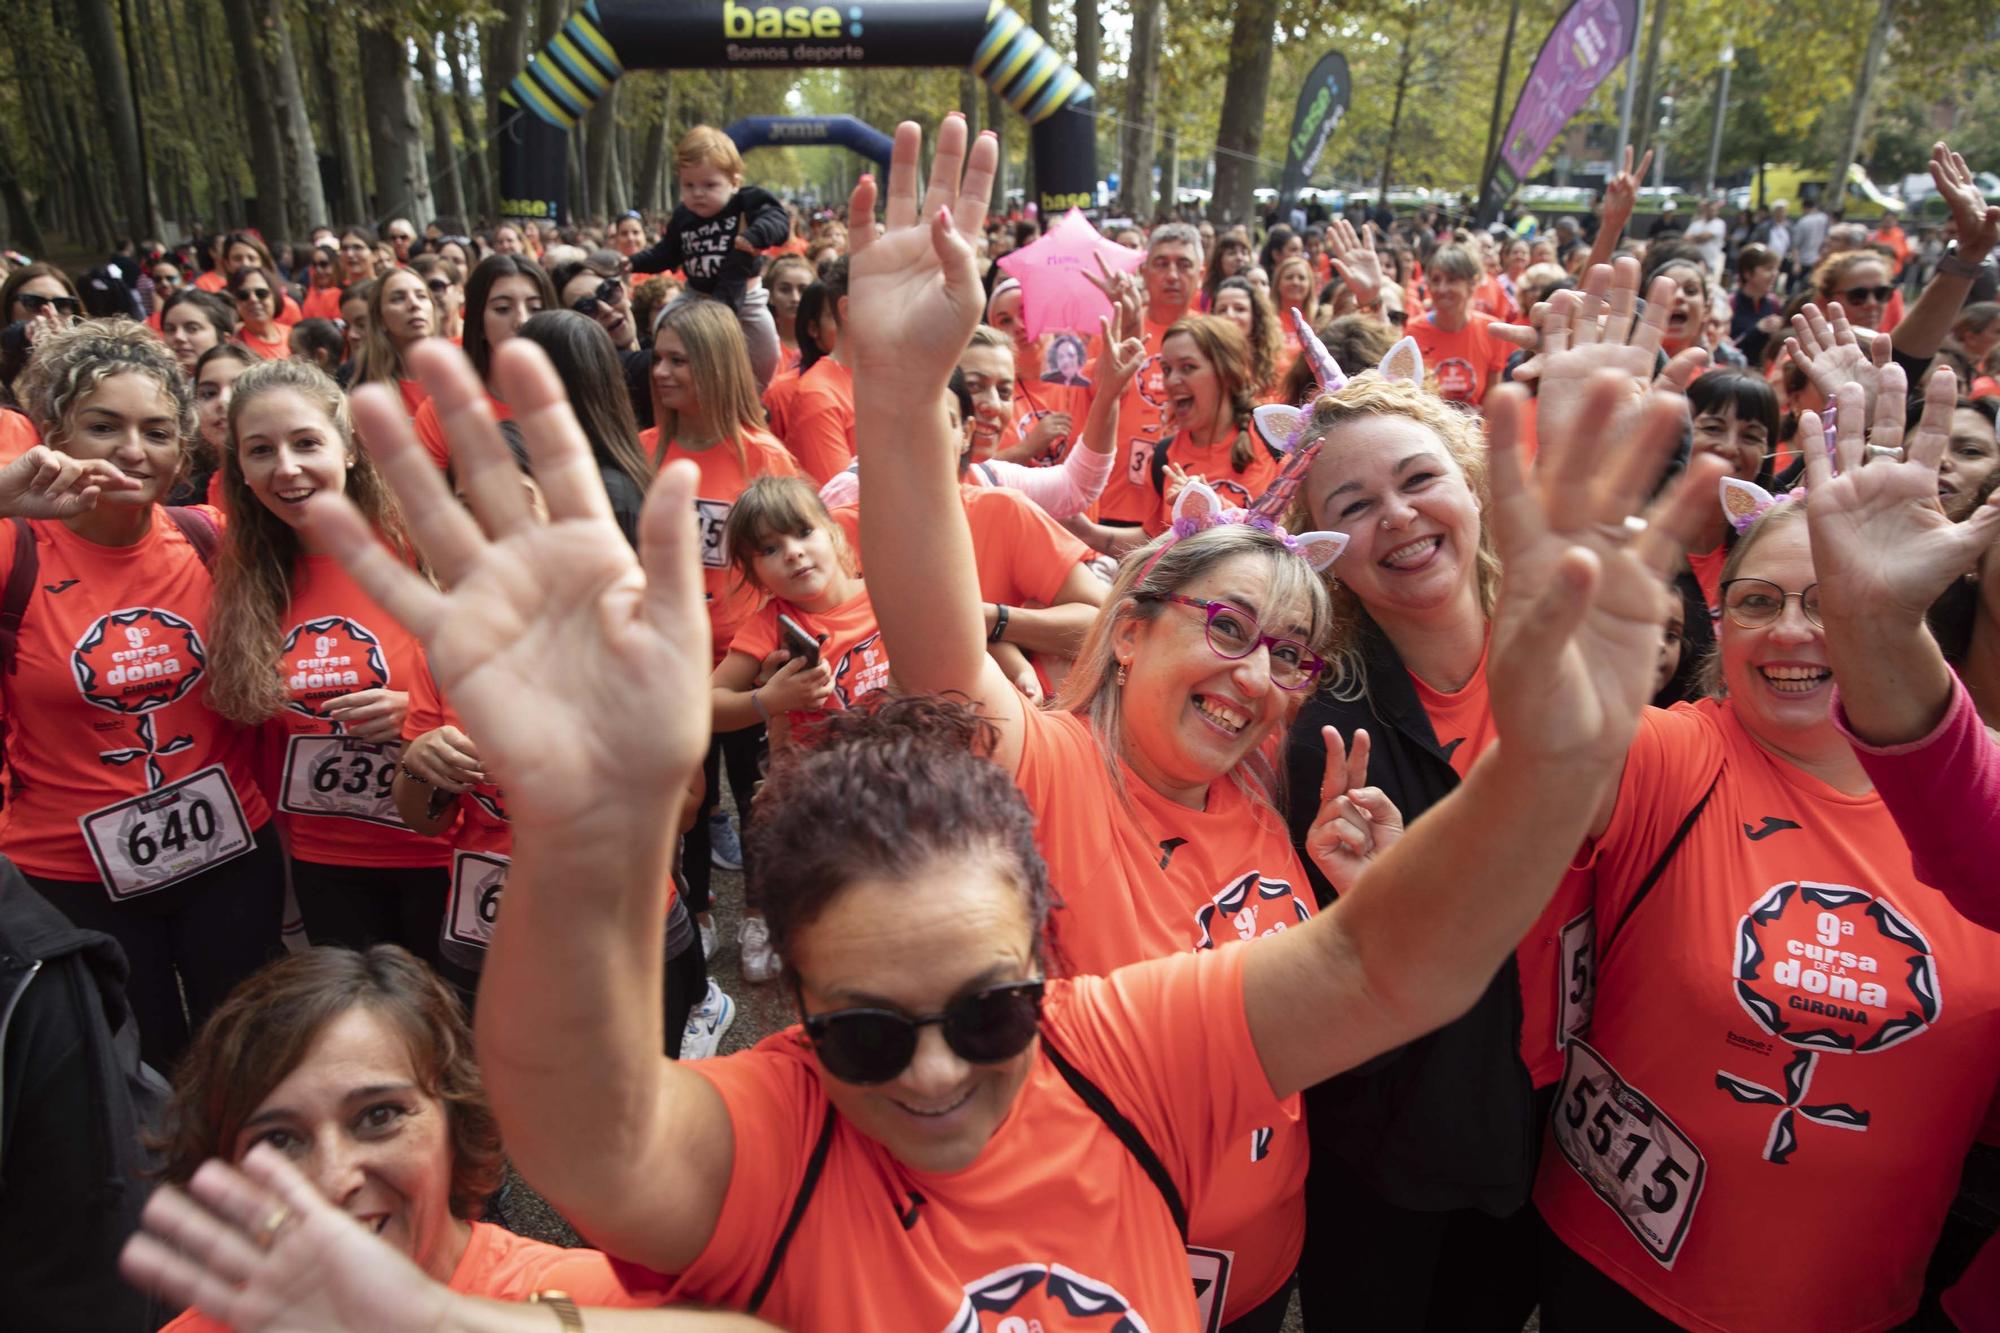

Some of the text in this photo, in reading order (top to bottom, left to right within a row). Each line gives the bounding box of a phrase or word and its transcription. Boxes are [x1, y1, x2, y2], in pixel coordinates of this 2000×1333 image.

[727, 44, 864, 62] Somos deporte
[1132, 451, 1151, 471] 3
[111, 644, 170, 662] cursa
[296, 656, 351, 669] cursa
[107, 658, 180, 685] dona
[290, 671, 358, 690] dona
[123, 679, 173, 696] GIRONA
[314, 756, 396, 798] 639
[128, 799, 216, 866] 640
[1786, 939, 1878, 973] cursa
[1814, 961, 1846, 976] DE LA
[1773, 958, 1888, 1009] dona
[1788, 995, 1869, 1026] GIRONA
[1564, 1075, 1690, 1214] 5515
